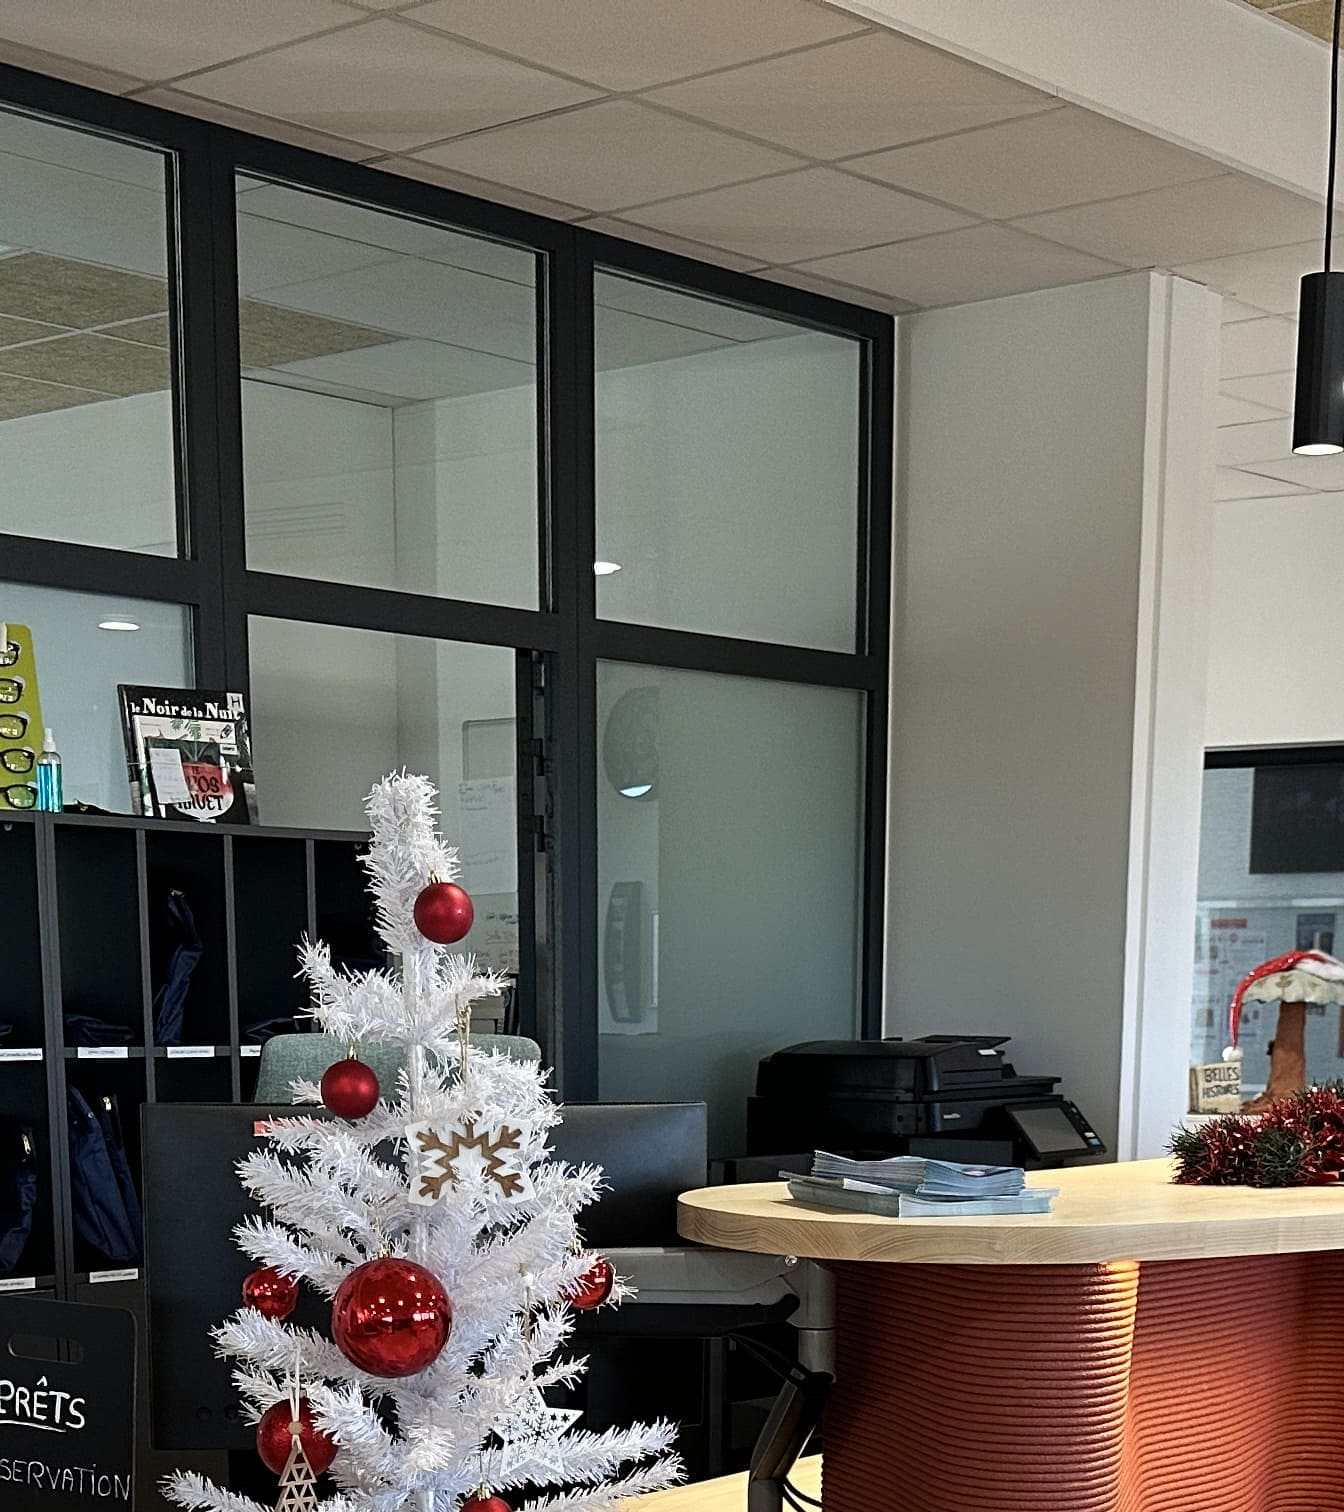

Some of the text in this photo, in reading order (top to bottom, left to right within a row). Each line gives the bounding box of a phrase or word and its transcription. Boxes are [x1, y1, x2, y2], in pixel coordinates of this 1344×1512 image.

[142, 698, 180, 716] Noir
[181, 706, 192, 717] de
[193, 707, 204, 718] la
